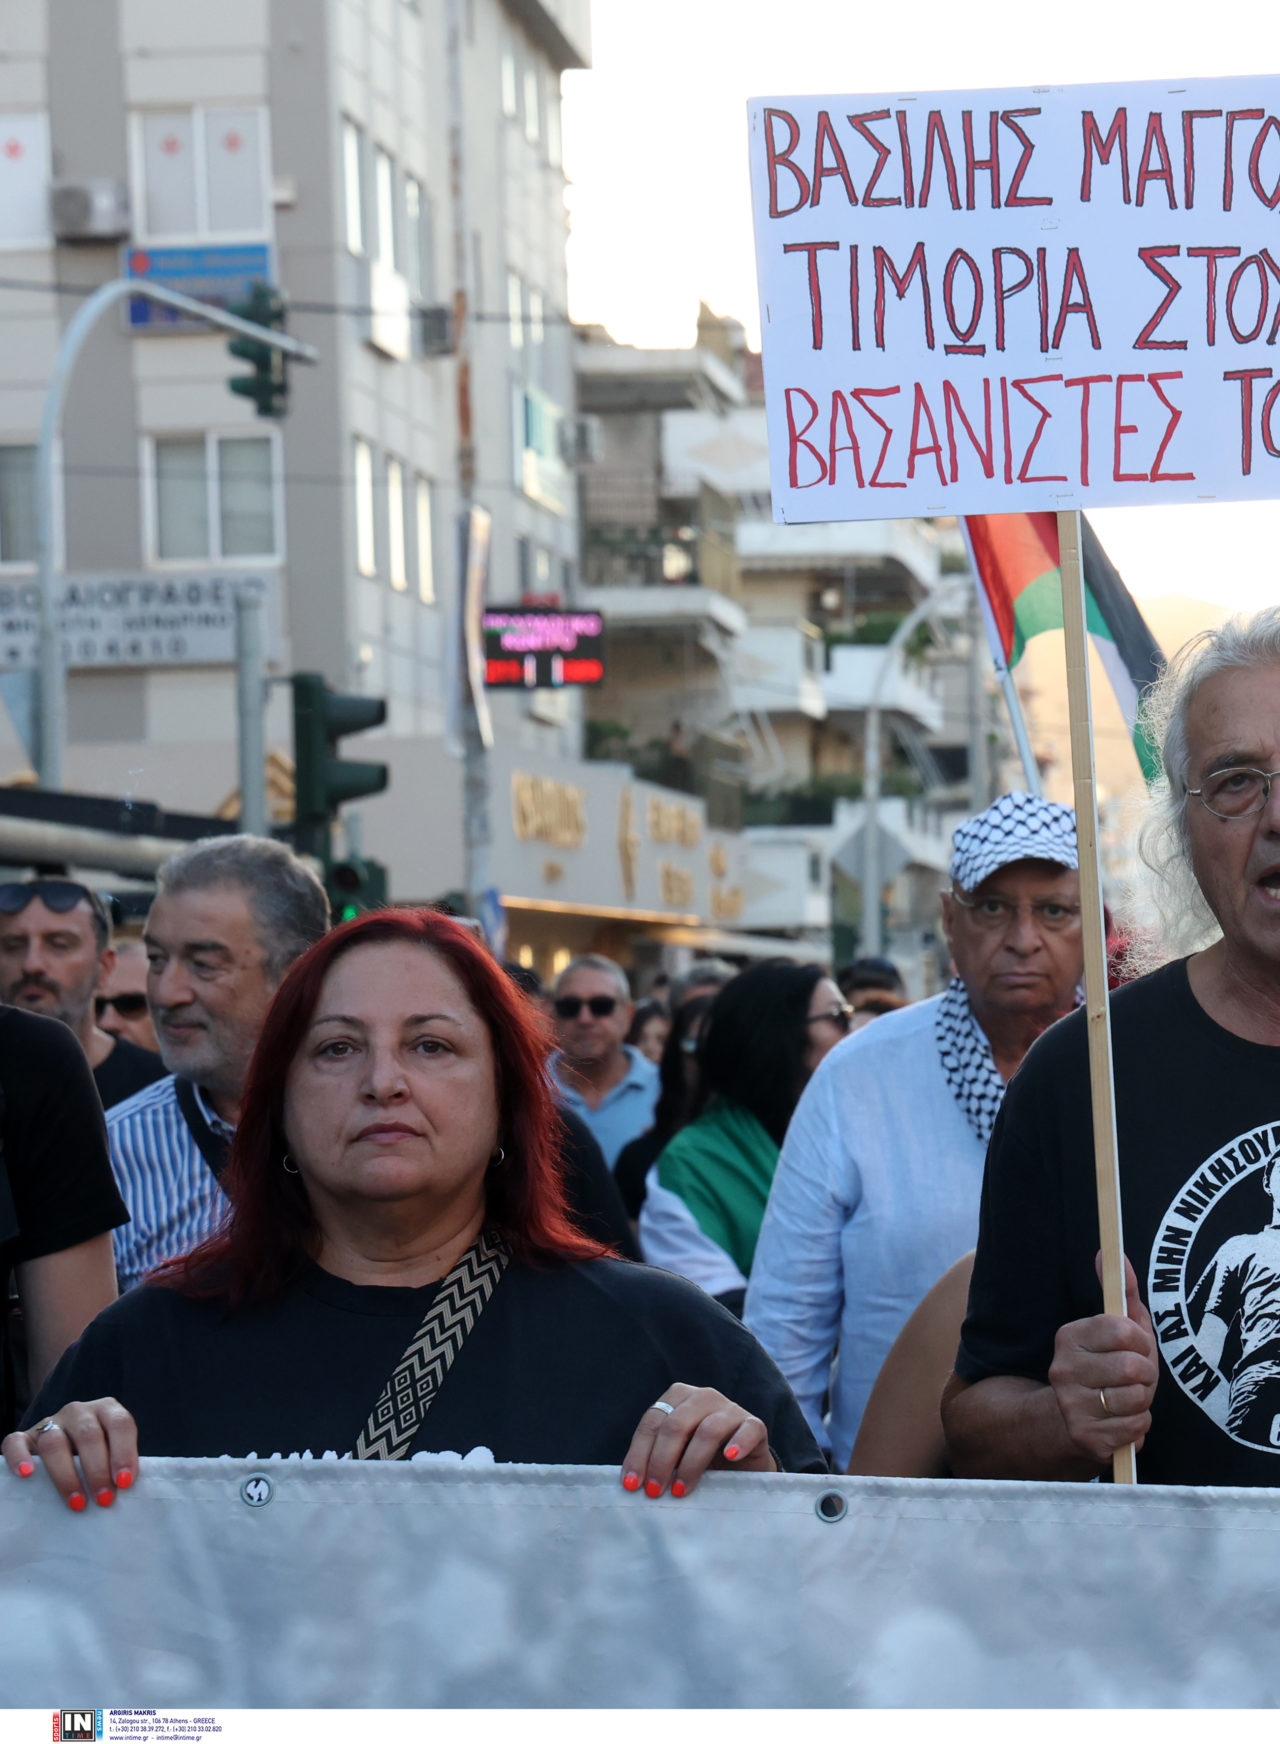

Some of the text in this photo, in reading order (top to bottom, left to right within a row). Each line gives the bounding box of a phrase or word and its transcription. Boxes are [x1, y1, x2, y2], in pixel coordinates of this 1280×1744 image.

[764, 107, 1053, 219] ΒΑΣΙΛΗΣ
[784, 371, 1196, 489] ΒΑΣΑΝΙΣΤΕΣ
[1152, 1225, 1194, 1293] ΜΗΝ
[1153, 1302, 1189, 1344] ΑΣ
[1172, 1344, 1221, 1402] ΚΑΙ
